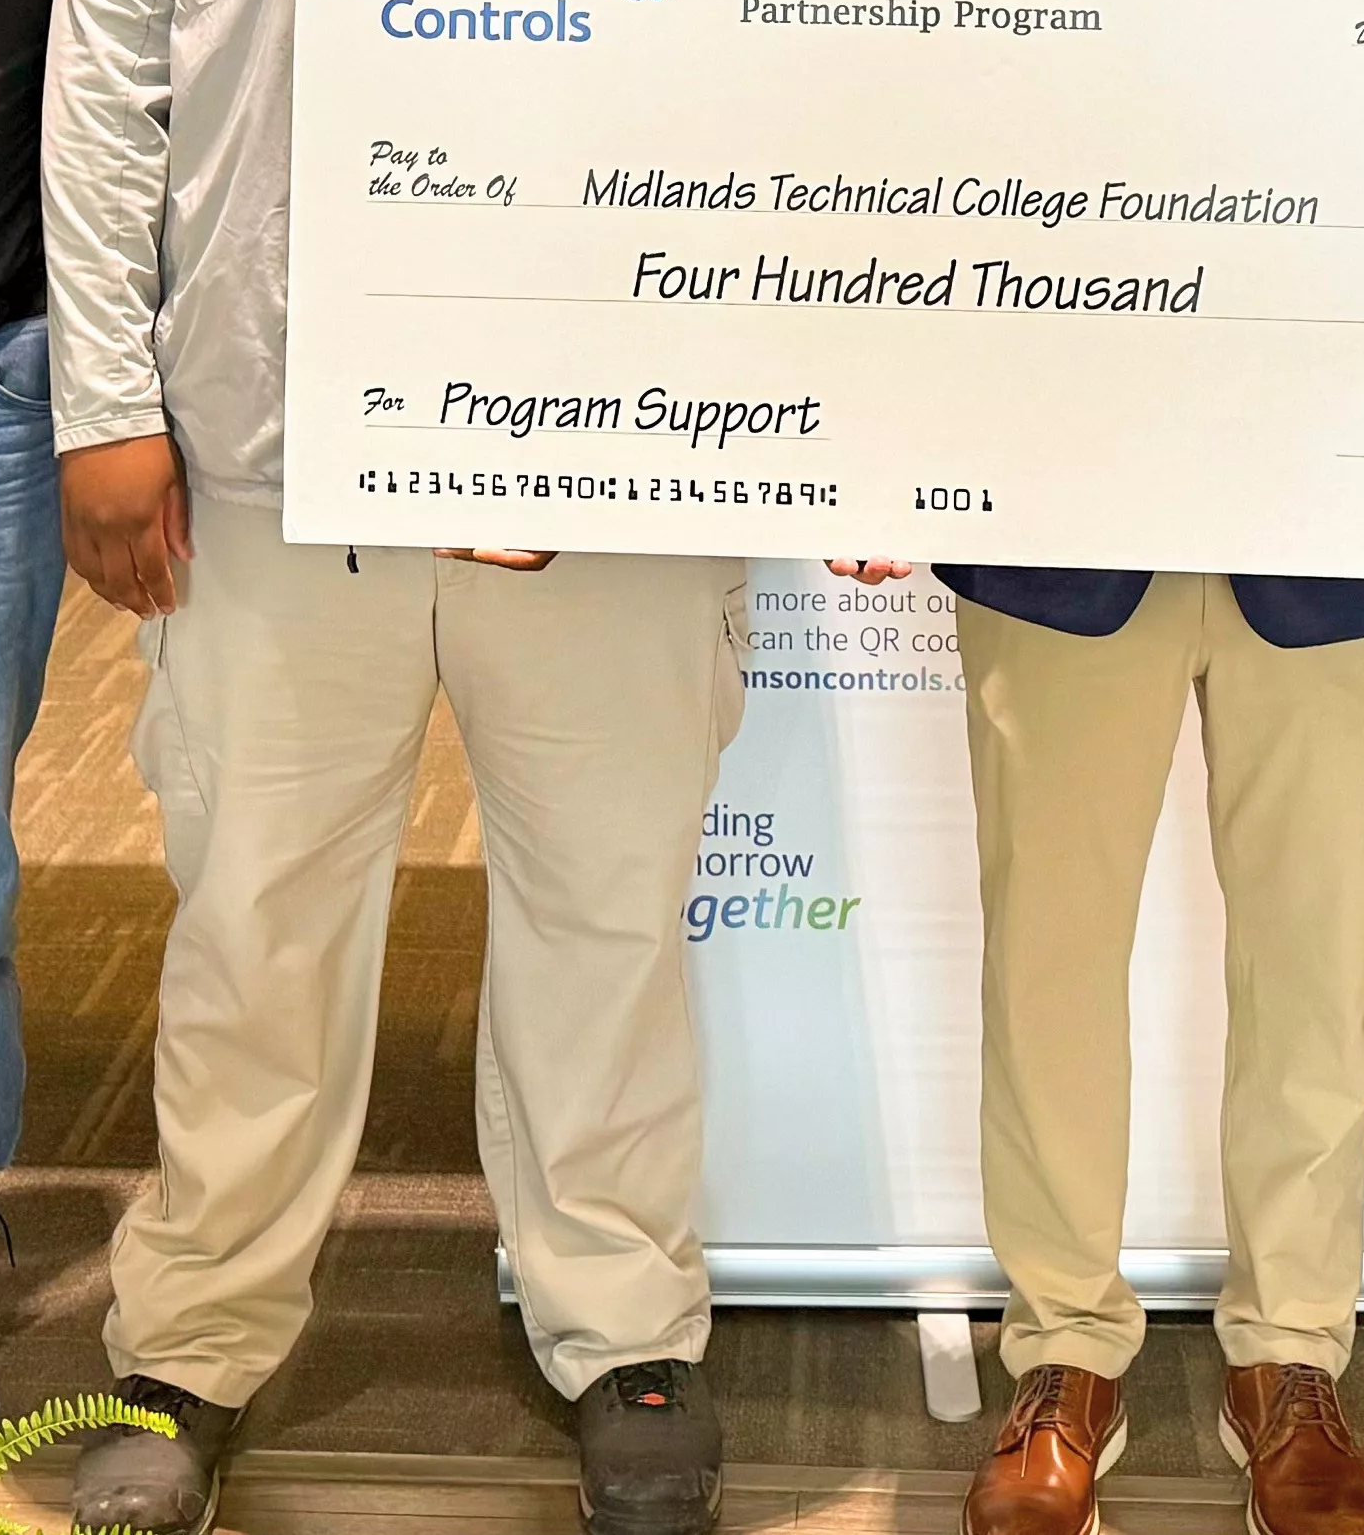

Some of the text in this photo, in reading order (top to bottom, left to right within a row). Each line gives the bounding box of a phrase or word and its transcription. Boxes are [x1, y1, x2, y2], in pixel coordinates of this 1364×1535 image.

[954, 0, 1103, 36] Program
[370, 140, 448, 170] Pay to
[369, 172, 517, 206] the Order Of
[582, 168, 1319, 228] Midlands Technical College Foundation
[632, 251, 1205, 314] Four Hundred Thousand
[363, 381, 821, 450] For Program Support
[916, 487, 993, 512] 1001
[756, 592, 827, 612] more
[838, 587, 917, 613] about
[804, 626, 848, 651] the
[860, 627, 900, 657] QR
[697, 852, 814, 878] orrow
[681, 883, 862, 942] gether
